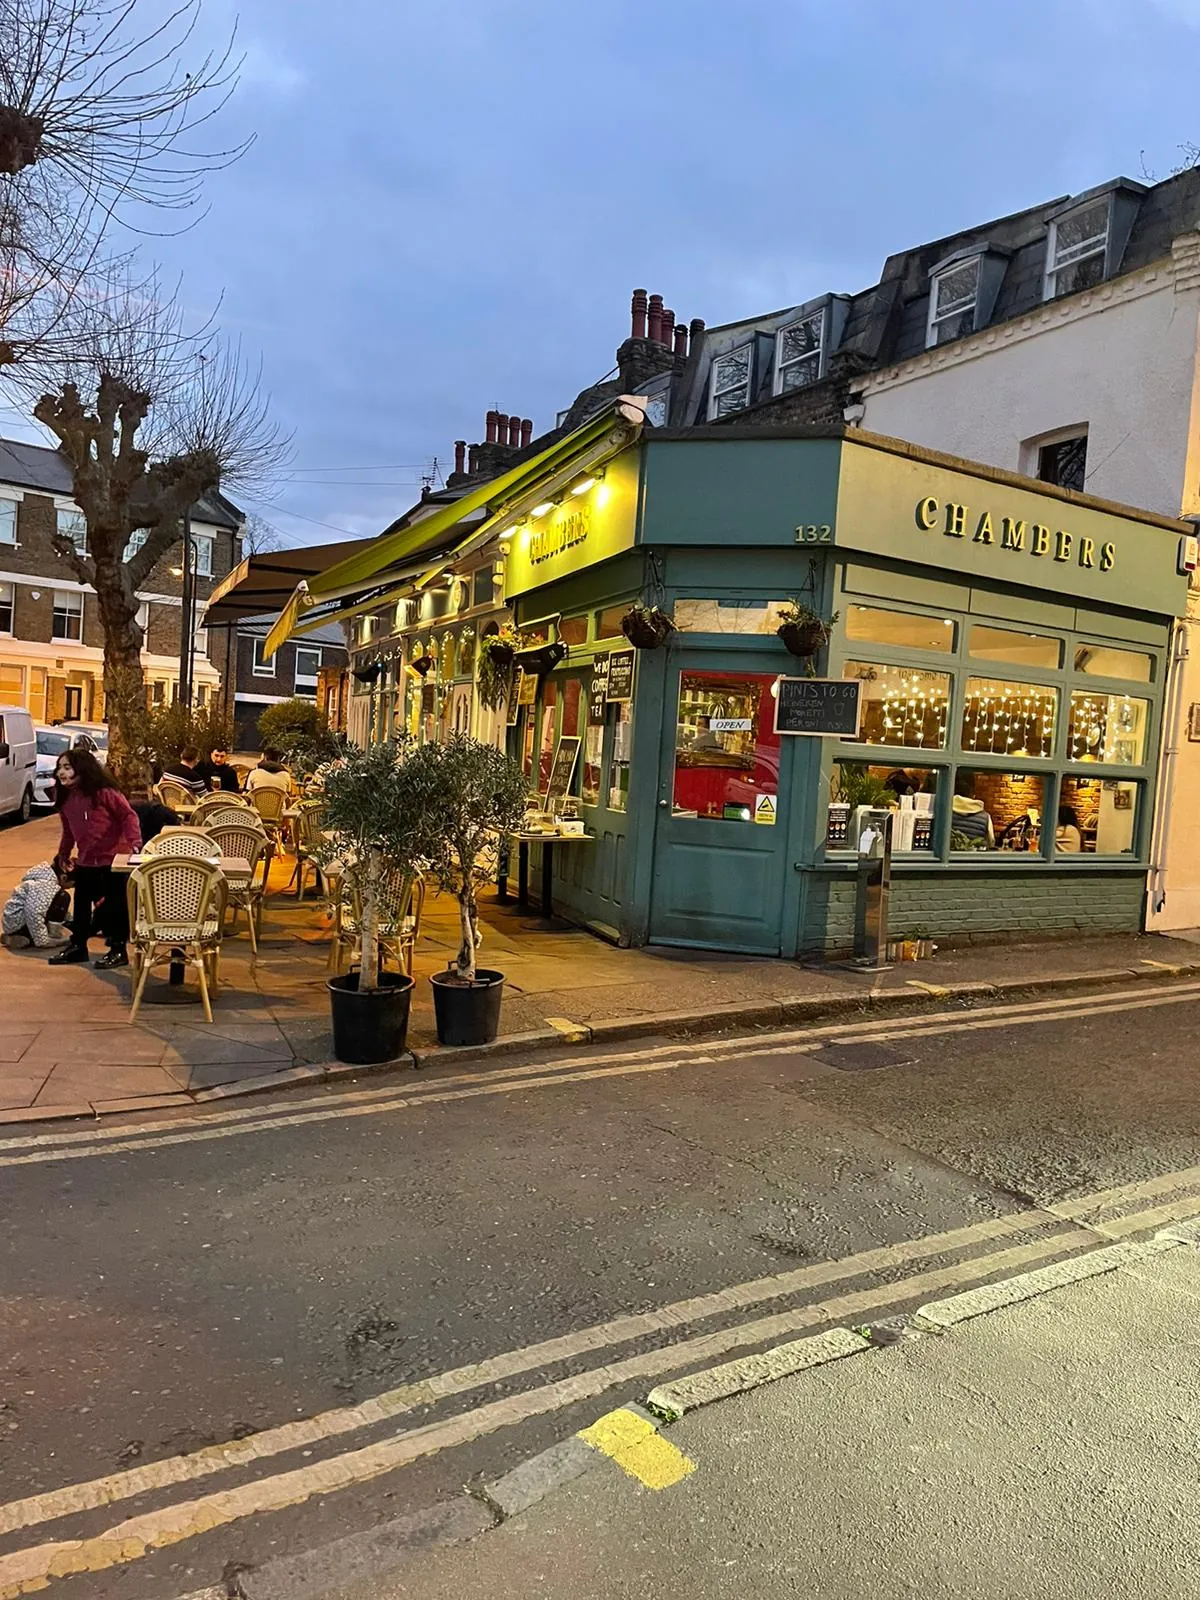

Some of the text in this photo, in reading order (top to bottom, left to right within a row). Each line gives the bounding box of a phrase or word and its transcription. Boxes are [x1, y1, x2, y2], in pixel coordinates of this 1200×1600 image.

[795, 525, 831, 542] 132
[916, 496, 1116, 572] CHAMBERS
[782, 683, 857, 698] PINTS TO GO
[716, 721, 745, 729] OPEN
